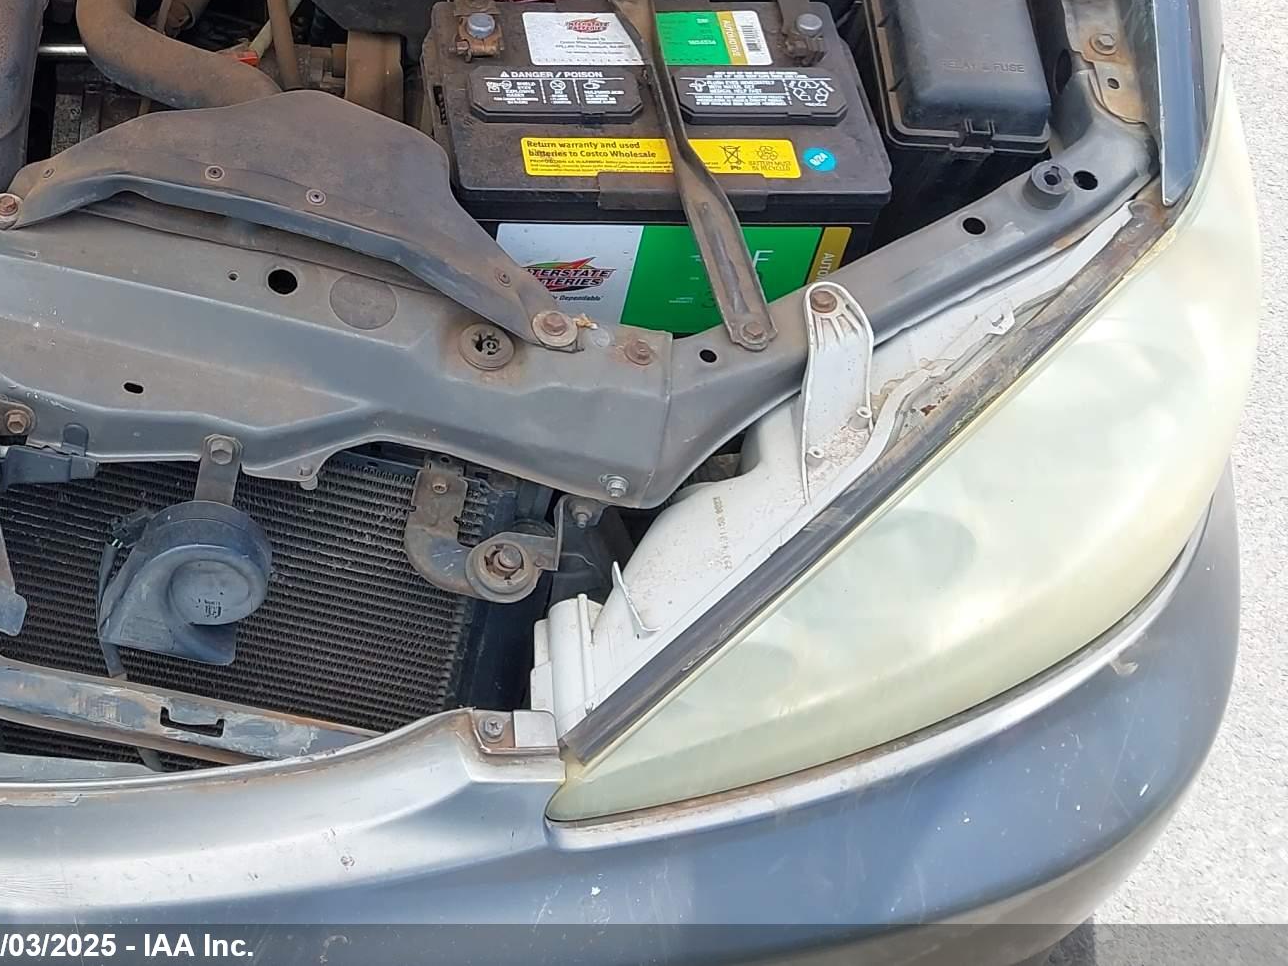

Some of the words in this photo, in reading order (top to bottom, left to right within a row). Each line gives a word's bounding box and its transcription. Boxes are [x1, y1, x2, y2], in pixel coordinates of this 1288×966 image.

[992, 62, 1025, 74] FUSE
[559, 142, 598, 150] warranty
[600, 141, 617, 149] and
[619, 141, 640, 149] used
[528, 149, 567, 157] batteries
[579, 150, 609, 158] Costco
[610, 150, 657, 158] Wholesale
